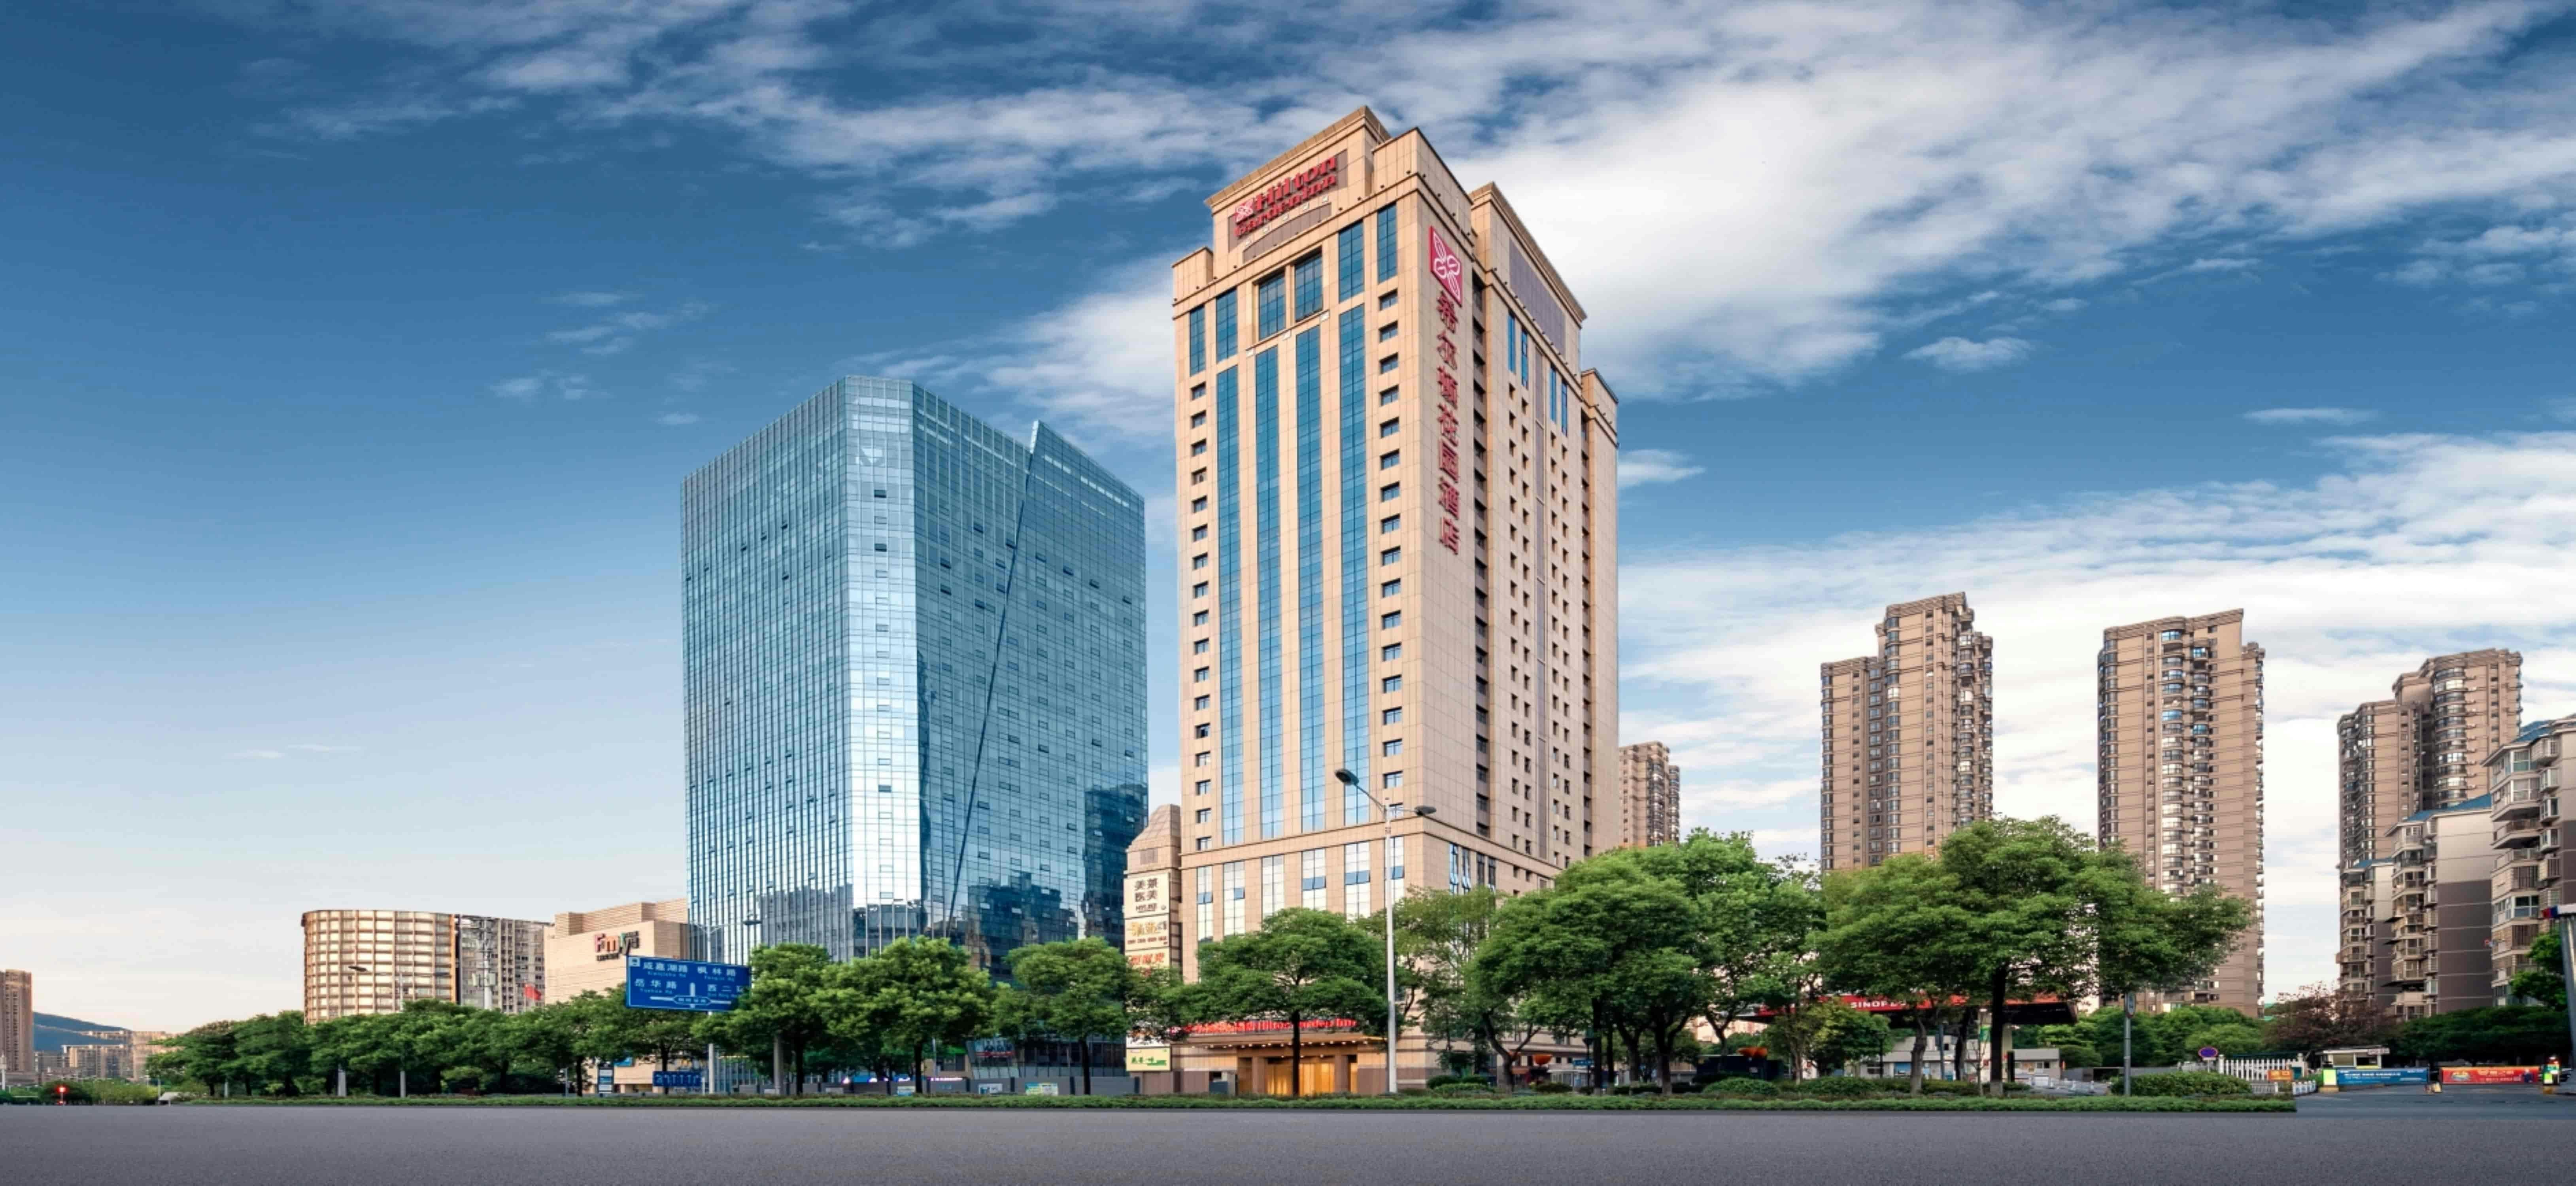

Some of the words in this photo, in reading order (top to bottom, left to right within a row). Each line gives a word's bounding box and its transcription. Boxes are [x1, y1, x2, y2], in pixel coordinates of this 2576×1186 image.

[1233, 195, 1302, 238] Garden
[1302, 174, 1336, 200] Inn
[1255, 156, 1336, 212] Hilton
[1436, 291, 1460, 555] 希尔顿花园酒店
[634, 978, 677, 990] 岳华路
[697, 966, 736, 977] 枫林路
